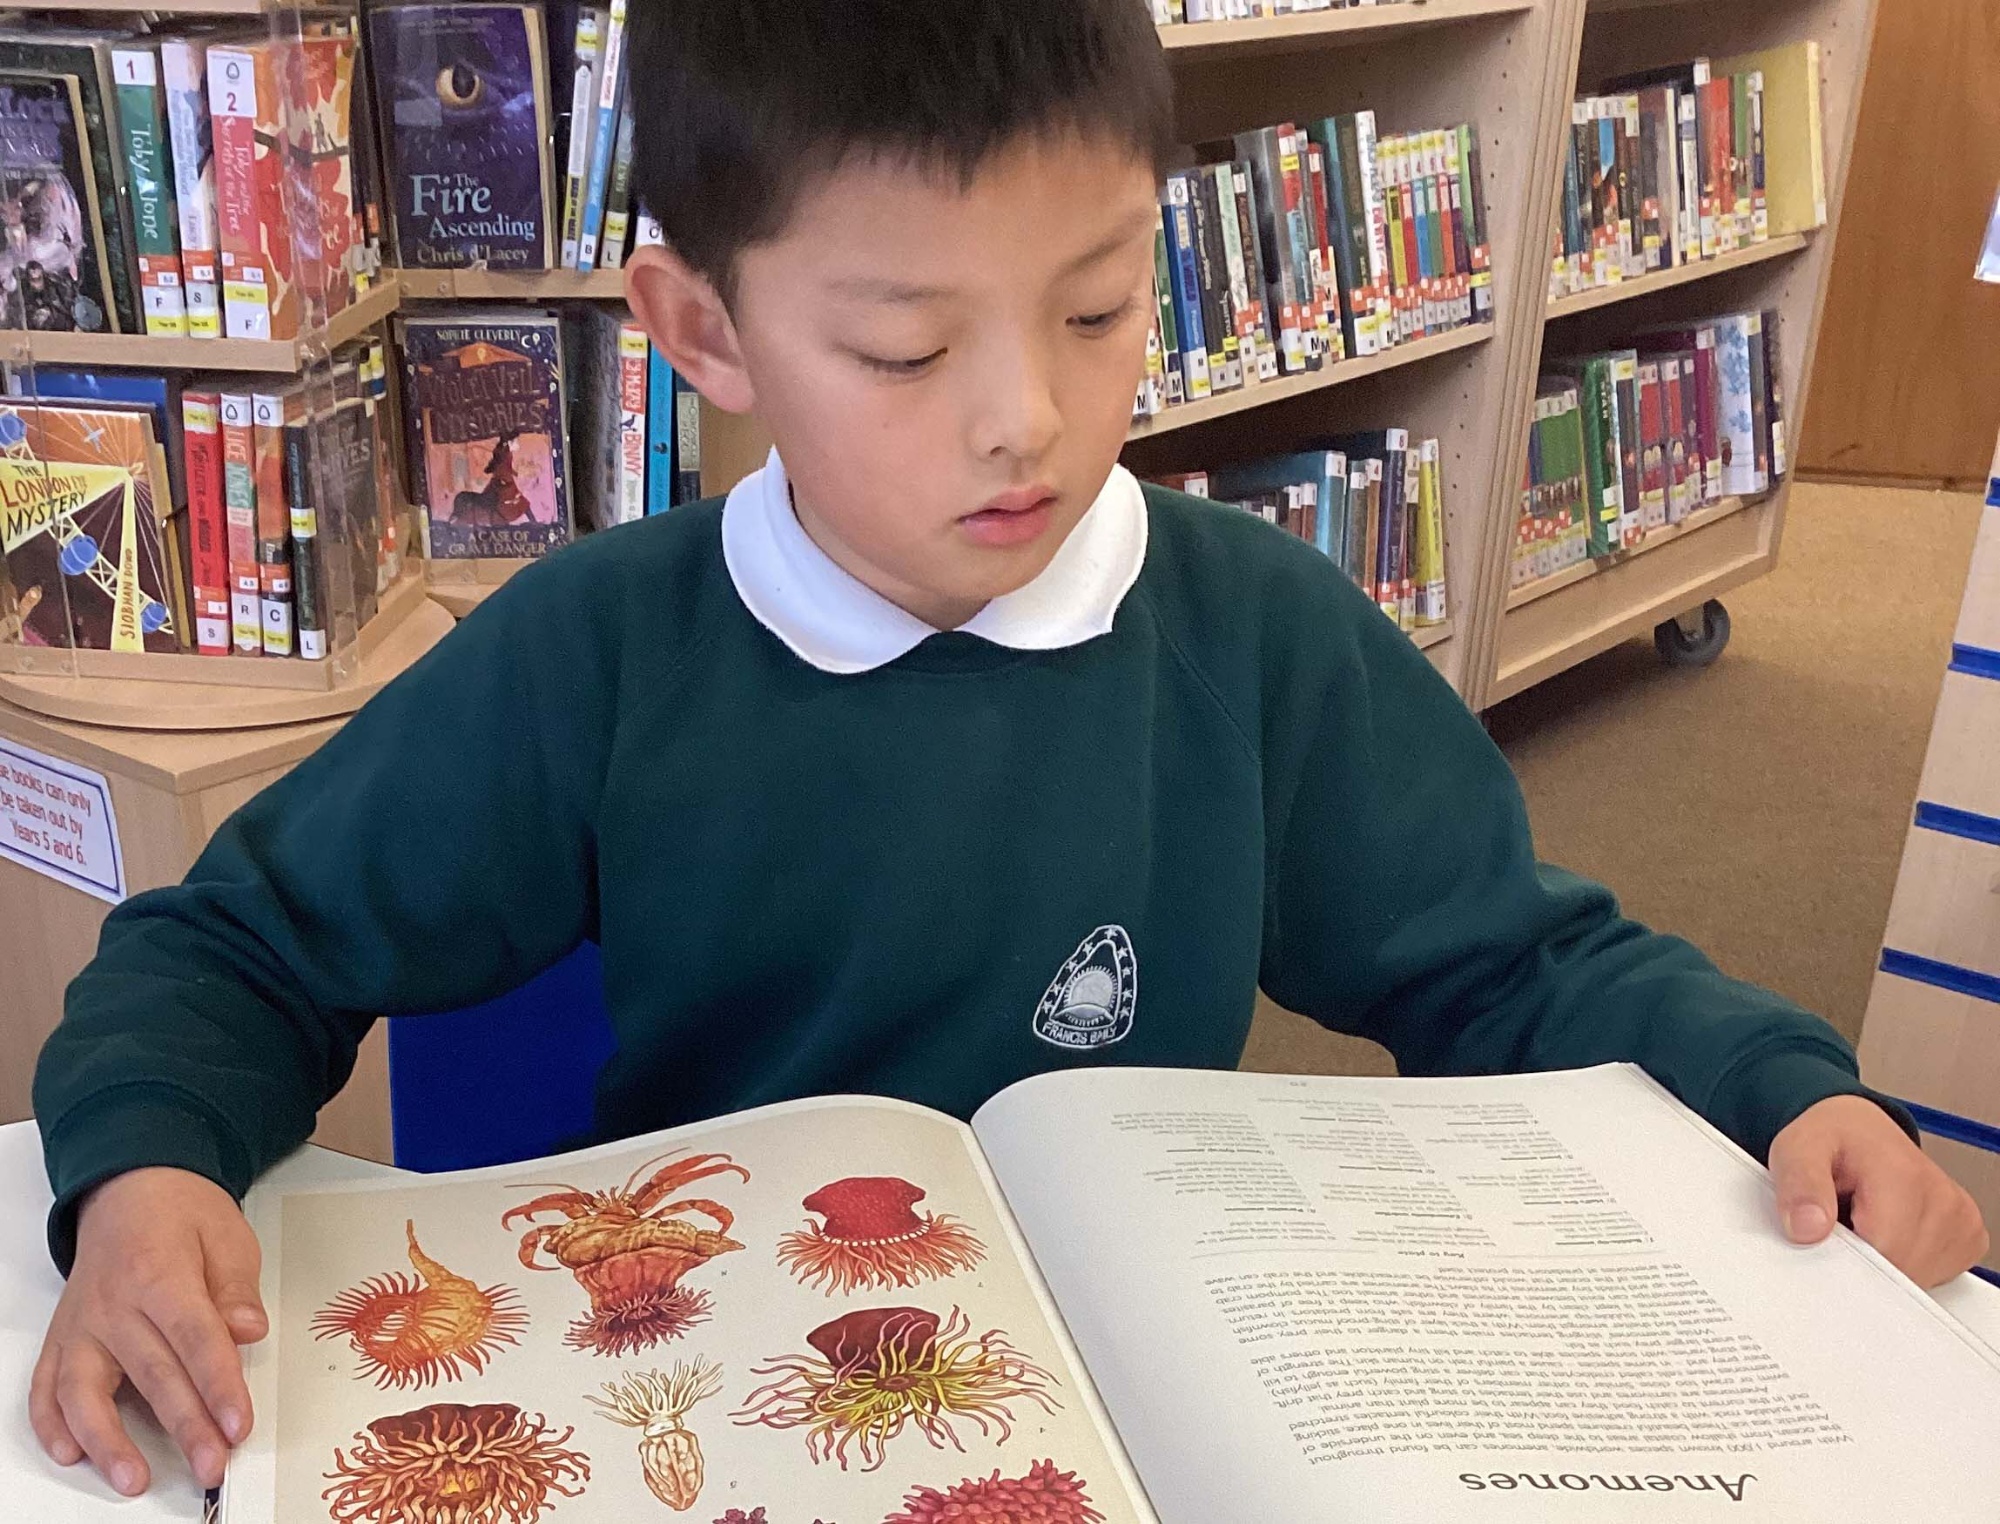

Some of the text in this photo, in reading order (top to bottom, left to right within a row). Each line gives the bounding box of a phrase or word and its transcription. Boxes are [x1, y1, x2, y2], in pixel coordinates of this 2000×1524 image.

[126, 59, 134, 80] 1
[226, 92, 237, 112] 2
[129, 123, 154, 172] Toby
[454, 174, 479, 187] The
[410, 174, 492, 216] Fire
[429, 213, 536, 242] Ascending
[417, 246, 464, 263] Chris
[584, 244, 592, 254] B
[607, 252, 613, 262] L
[156, 298, 162, 308] F
[194, 292, 202, 303] S
[245, 320, 252, 330] F
[490, 365, 541, 398] VEIL
[435, 401, 545, 438] MYSTERIES
[624, 433, 642, 477] BINNY
[12, 464, 44, 476] THE
[227, 463, 252, 507] JONES
[0, 475, 72, 508] LONDON
[6, 490, 86, 542] MYSTERY
[479, 531, 510, 541] CASE
[514, 530, 530, 541] OF
[448, 542, 546, 556] GRAVE DANGER
[120, 581, 136, 639] SIOBHAN
[241, 605, 249, 614] R
[270, 610, 281, 622] C
[208, 628, 216, 638] S
[306, 640, 312, 650] L
[10, 764, 44, 794] books
[46, 782, 66, 802] can
[68, 790, 90, 817] only
[16, 795, 46, 822] taken
[49, 810, 67, 831] out
[69, 815, 82, 840] by
[10, 816, 40, 847] Years
[42, 830, 50, 850] 5
[54, 840, 73, 860] and
[1042, 1022, 1087, 1044] FRANCIS
[1247, 1288, 1302, 1299] pompom
[1233, 1322, 1288, 1334] clownfish
[1239, 1334, 1274, 1344] some
[1281, 1351, 1321, 1359] others
[1409, 1347, 1429, 1355] tiny
[1251, 1356, 1276, 1365] able
[1274, 1361, 1324, 1372] strength
[1302, 1371, 1349, 1379] enough
[1354, 1368, 1408, 1376] powerful
[1344, 1378, 1379, 1387] (such
[1384, 1378, 1419, 1386] family
[1336, 1390, 1364, 1398] prey
[1429, 1387, 1458, 1395] sting
[1308, 1394, 1332, 1403] that
[1400, 1399, 1429, 1407] plant
[1354, 1412, 1411, 1420] tentacles
[1289, 1415, 1350, 1431] stretched
[1344, 1423, 1379, 1432] place,
[1295, 1429, 1341, 1441] sticking
[1321, 1436, 1386, 1449] underside
[1390, 1446, 1428, 1454] found
[1308, 1448, 1384, 1465] throughout
[1459, 1474, 1758, 1502] Anemones
